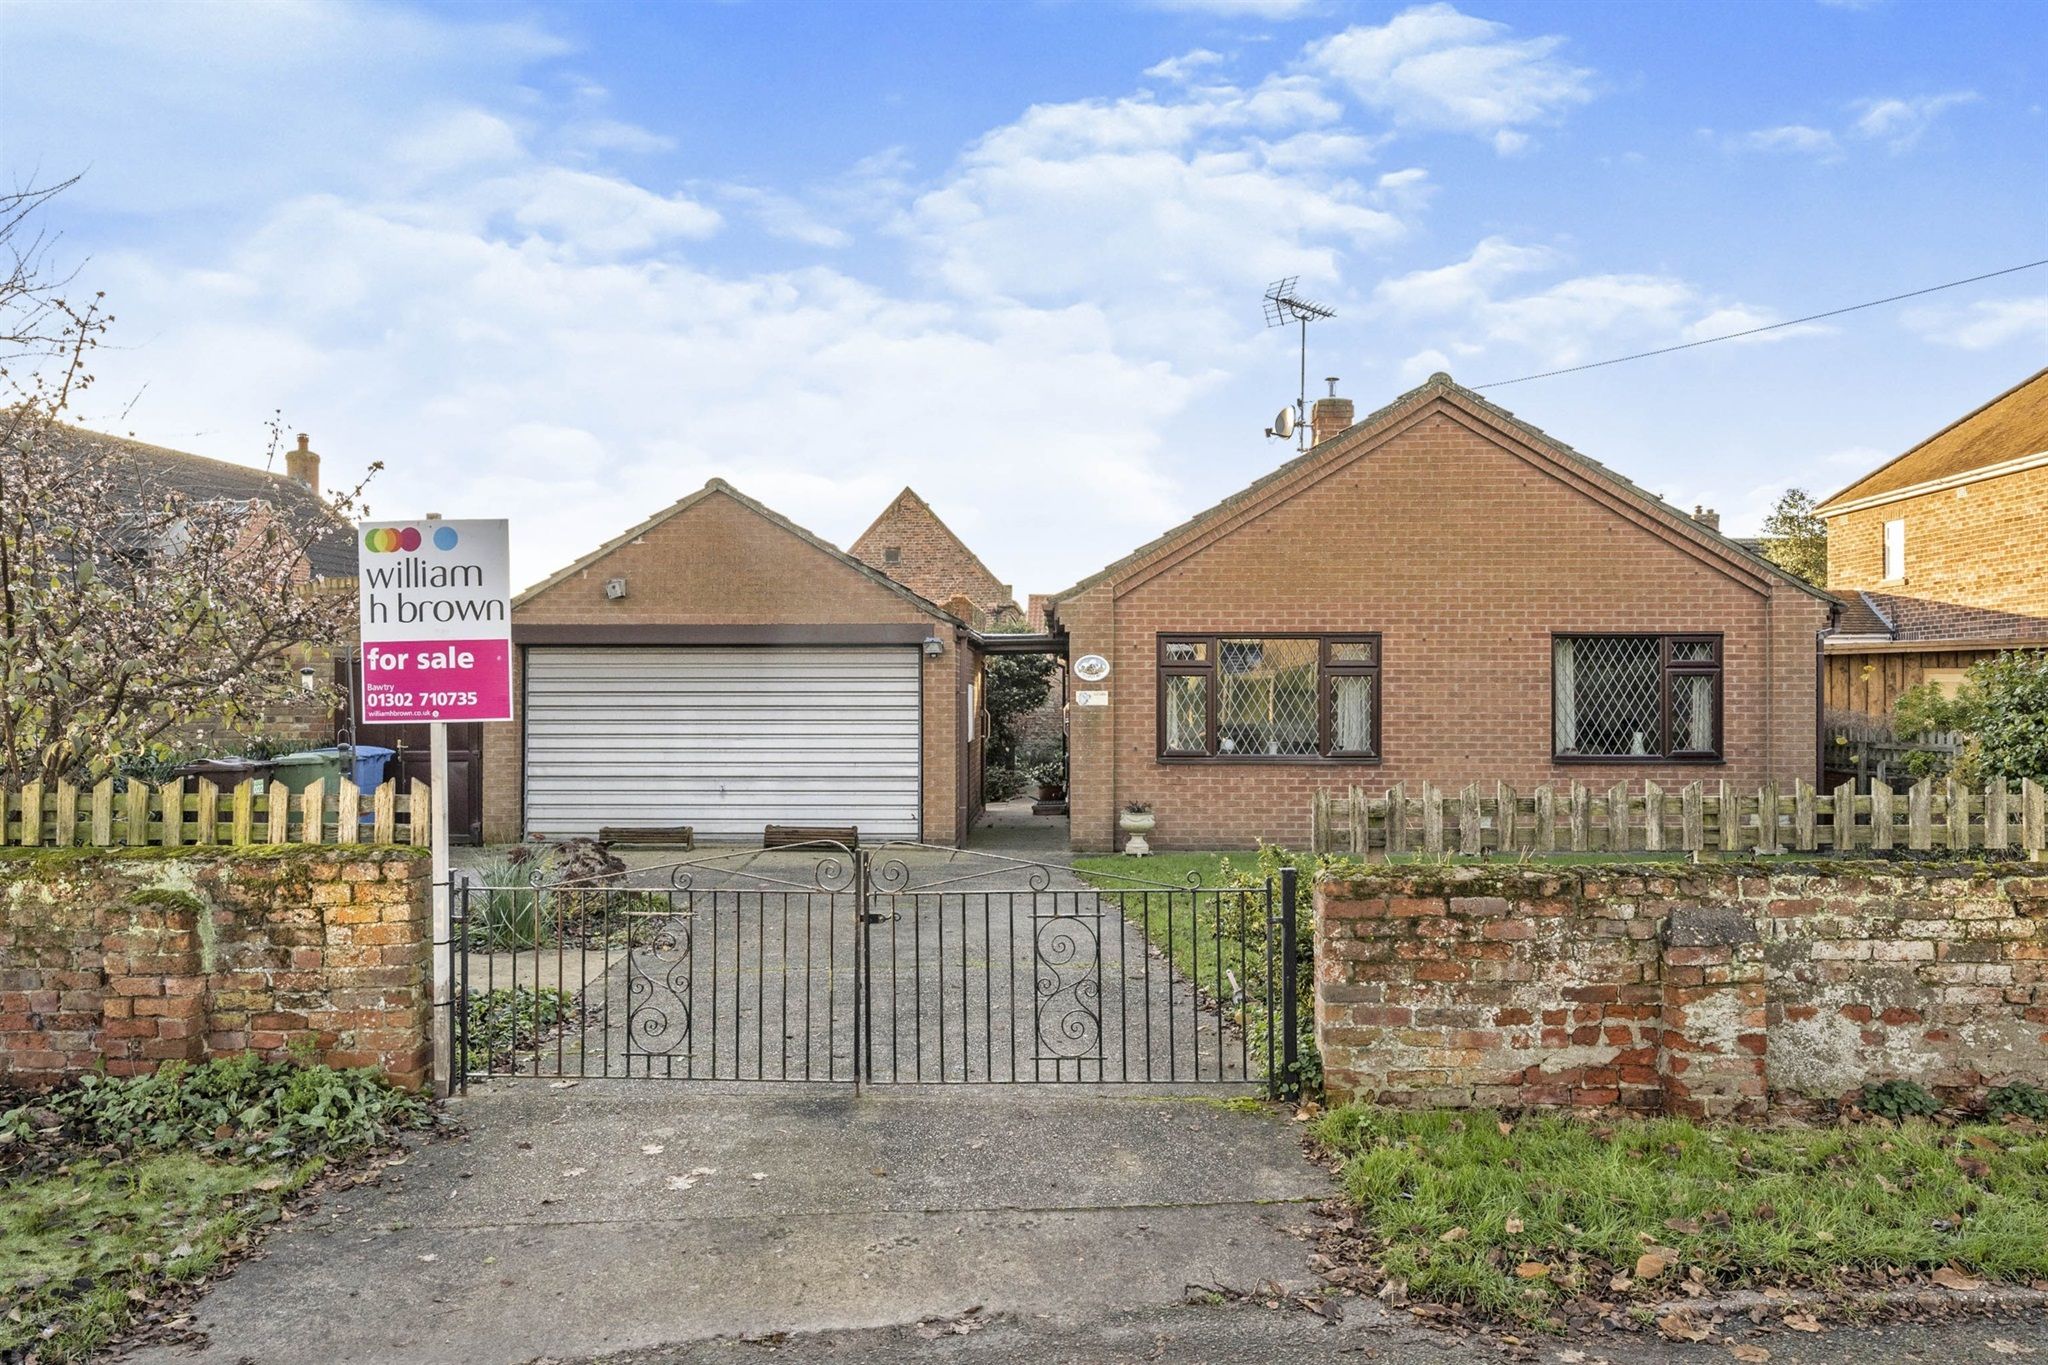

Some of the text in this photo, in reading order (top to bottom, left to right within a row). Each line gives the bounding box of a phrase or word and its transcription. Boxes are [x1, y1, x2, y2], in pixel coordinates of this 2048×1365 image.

[366, 557, 483, 589] william
[370, 593, 505, 623] h brown
[367, 646, 475, 671] for sale
[367, 683, 395, 692] Bawtry
[368, 691, 478, 707] 01302 710735
